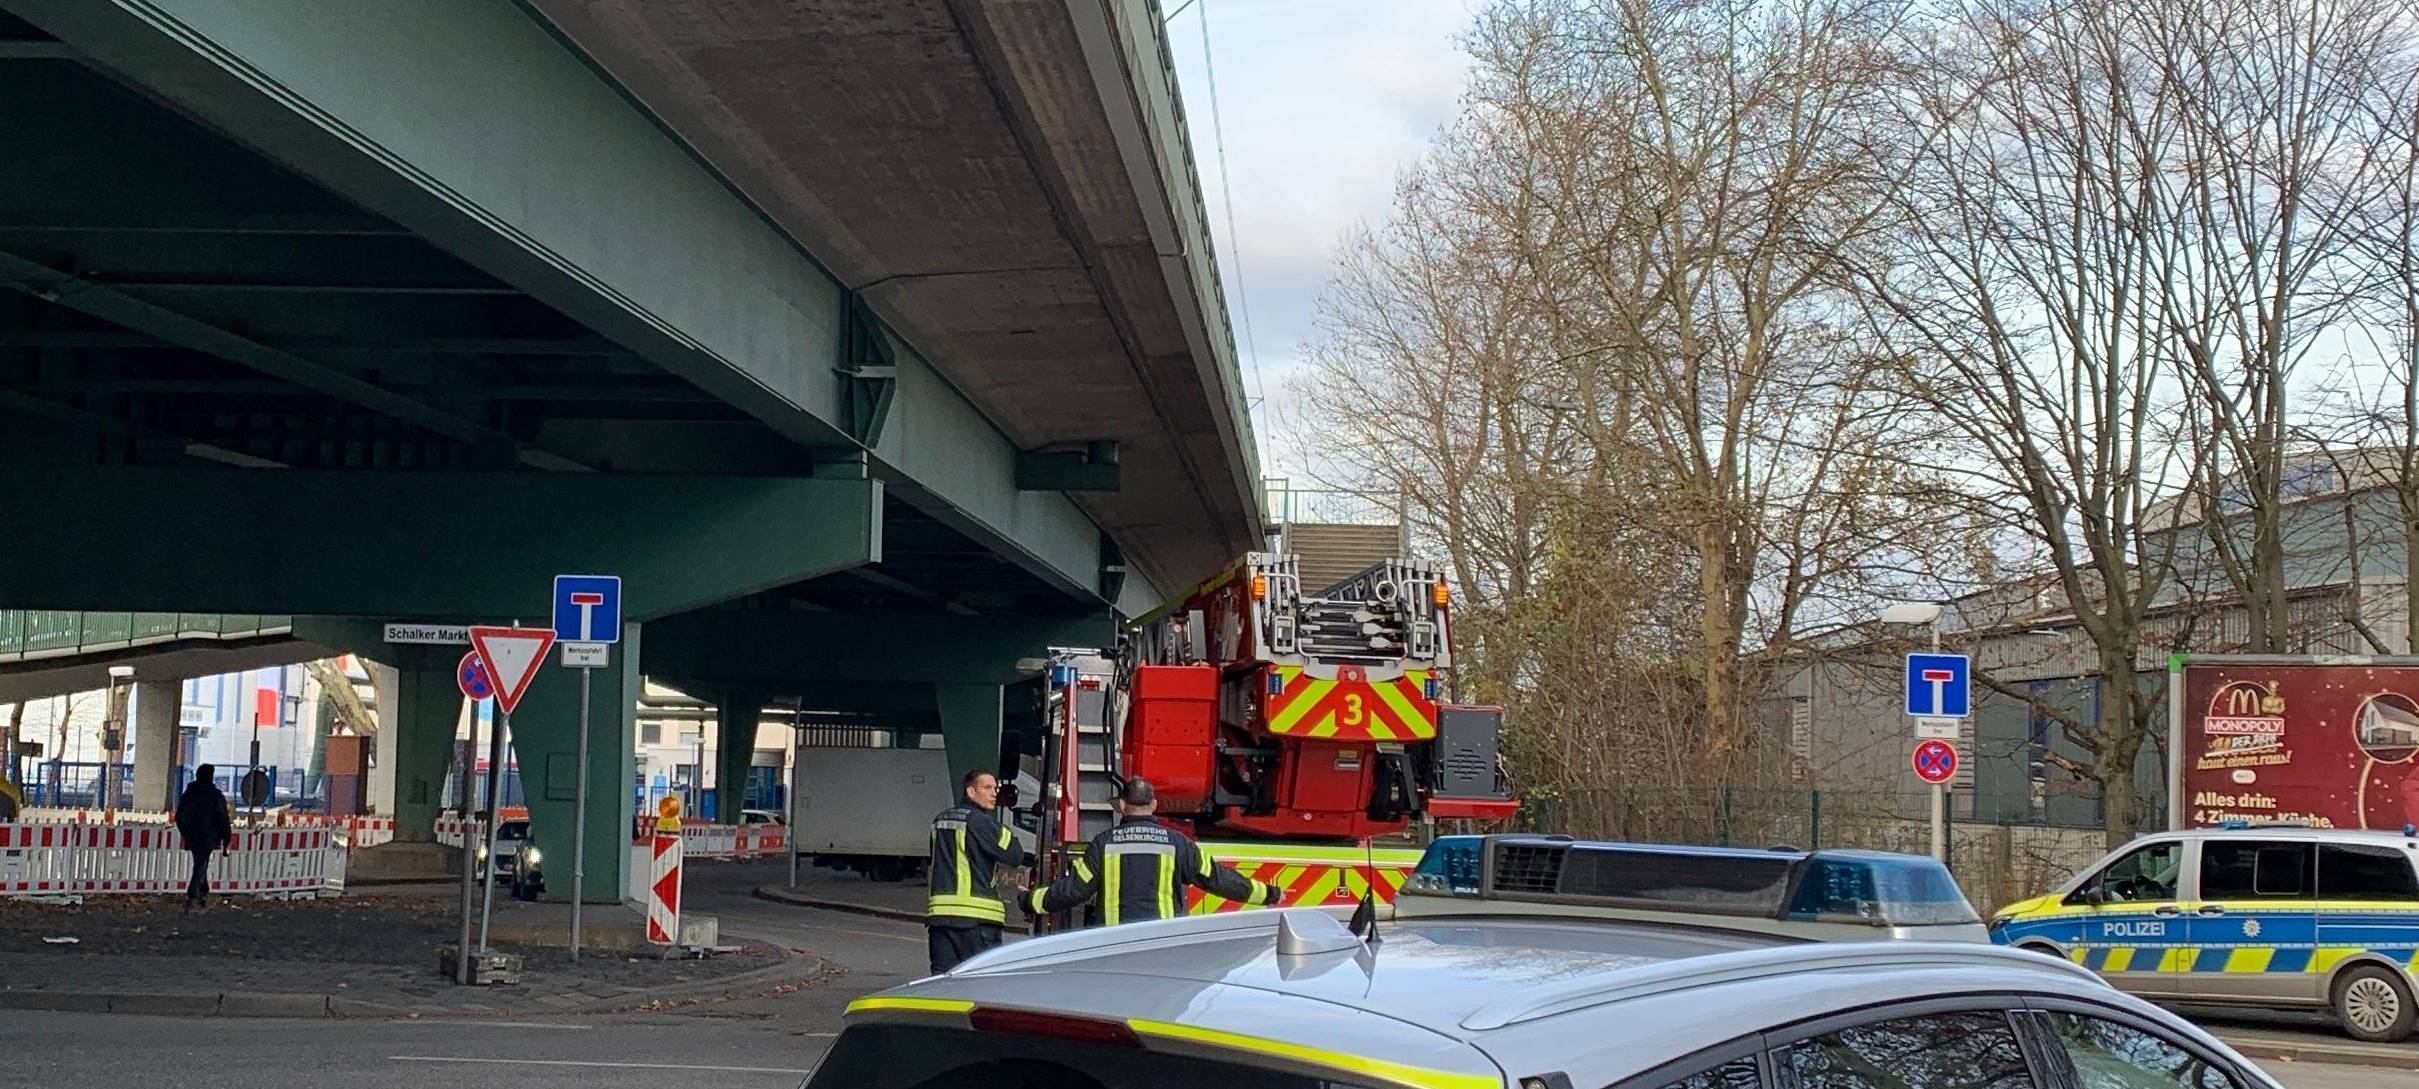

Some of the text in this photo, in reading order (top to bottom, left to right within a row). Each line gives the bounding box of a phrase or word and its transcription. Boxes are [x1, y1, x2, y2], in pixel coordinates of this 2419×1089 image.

[389, 627, 436, 640] Schalker
[1343, 693, 1363, 726] 3
[2208, 719, 2282, 732] MONOPOLY
[2197, 757, 2226, 770] haut
[2259, 750, 2293, 766] raus!
[2194, 791, 2277, 809] Alles drin:
[2194, 809, 2206, 824] 4
[1112, 826, 1169, 836] FEUERWEHR
[1112, 833, 1169, 843] GELSENKIRCHEN
[2103, 921, 2166, 937] POLIZEI
